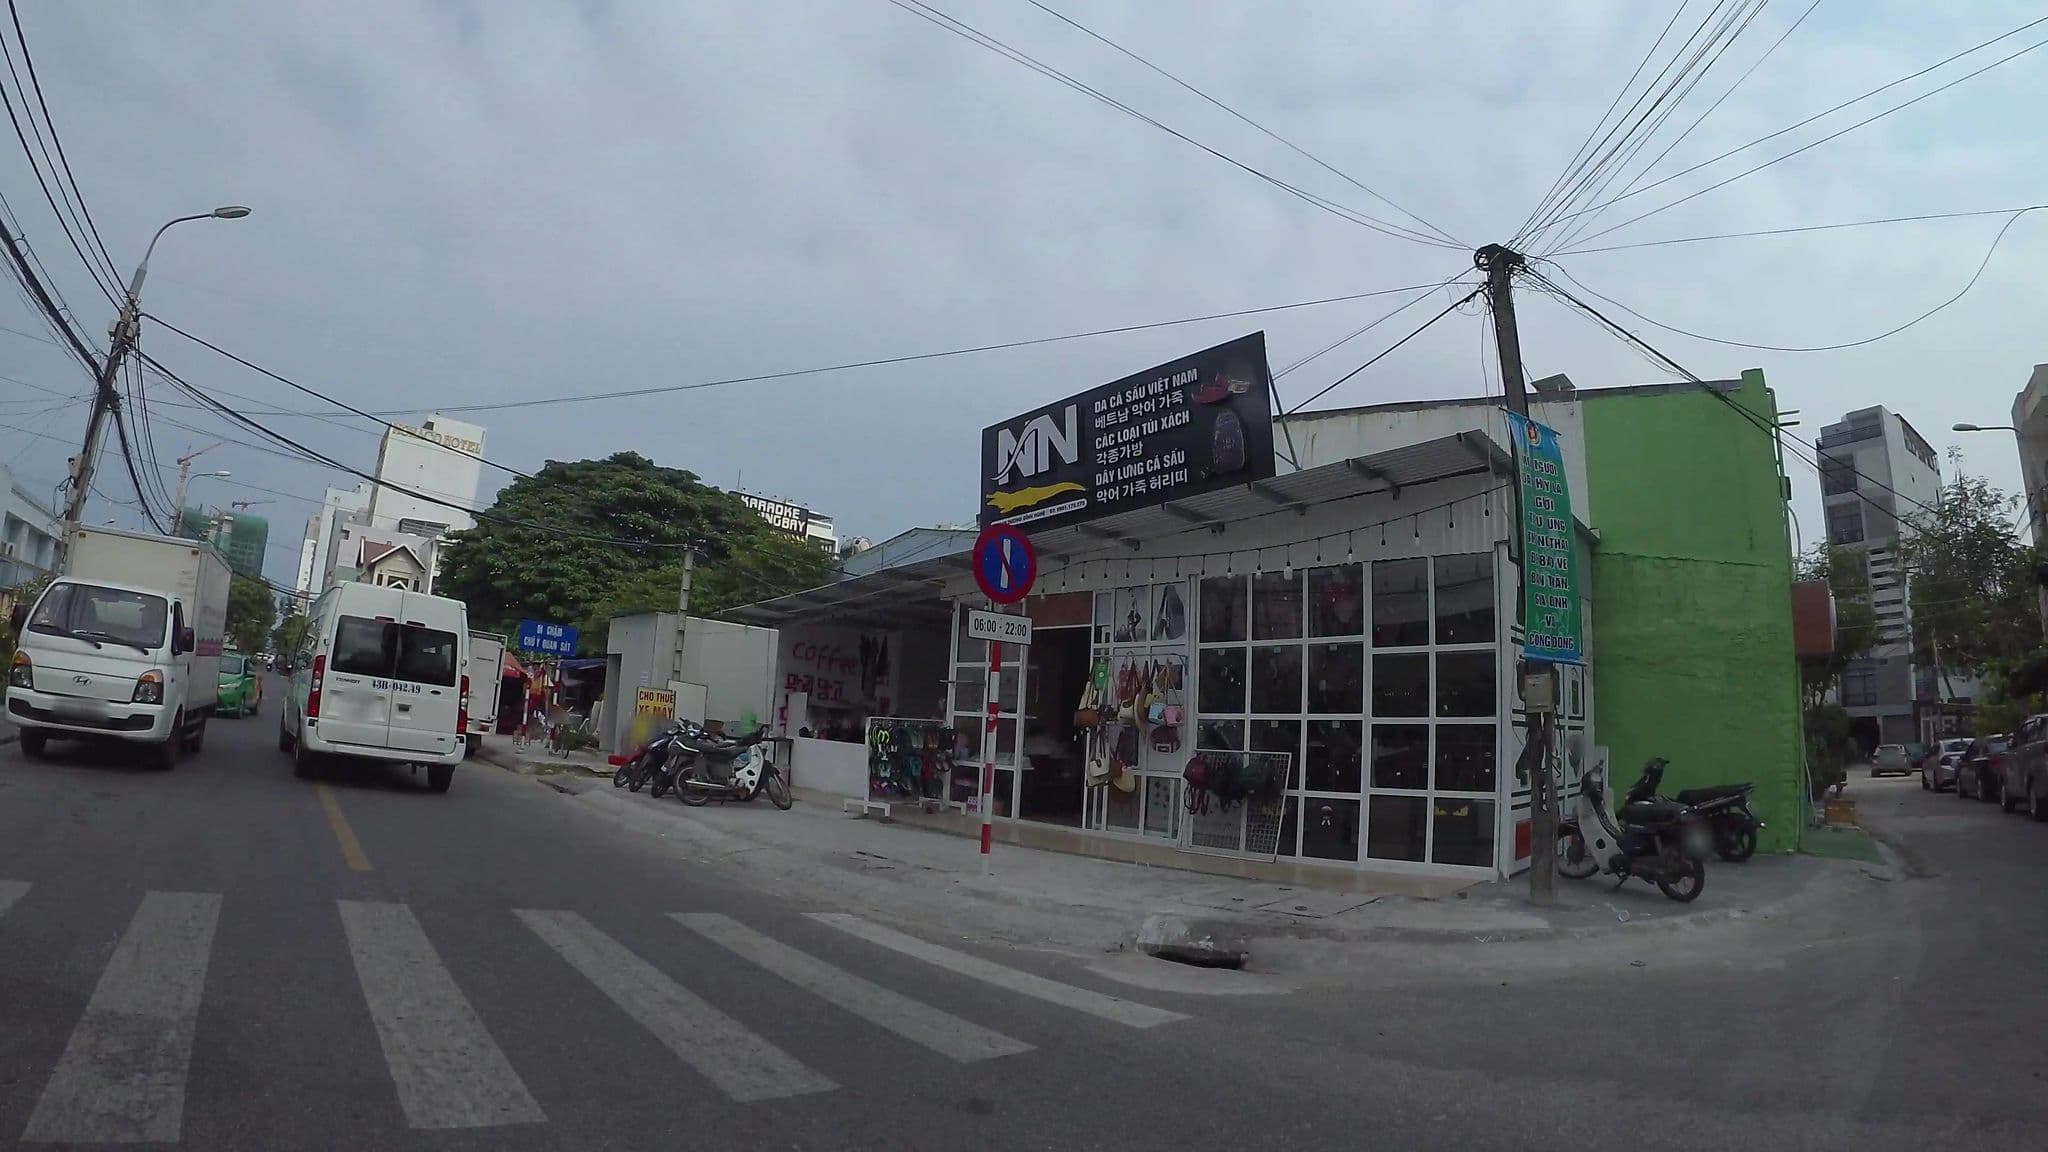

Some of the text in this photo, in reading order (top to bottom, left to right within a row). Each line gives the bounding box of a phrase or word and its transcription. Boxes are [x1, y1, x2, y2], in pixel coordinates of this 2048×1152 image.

[1148, 377, 1169, 395] VIỆT
[1172, 368, 1198, 387] NAM
[1094, 389, 1184, 429] 베트남 악어 가죽
[1095, 410, 1190, 450] CÁC LOẠI TÚI XÁCH
[443, 435, 481, 454] HOTEL
[1096, 440, 1144, 465] 각종가방
[1095, 469, 1115, 486] DÂY
[1096, 468, 1188, 503] 악어 가죽 허리띠
[740, 494, 801, 520] KARAOKE
[974, 617, 997, 633] 06:00
[1005, 622, 1027, 637] 22:00
[542, 638, 558, 650] QUAN
[639, 690, 654, 702] CHO
